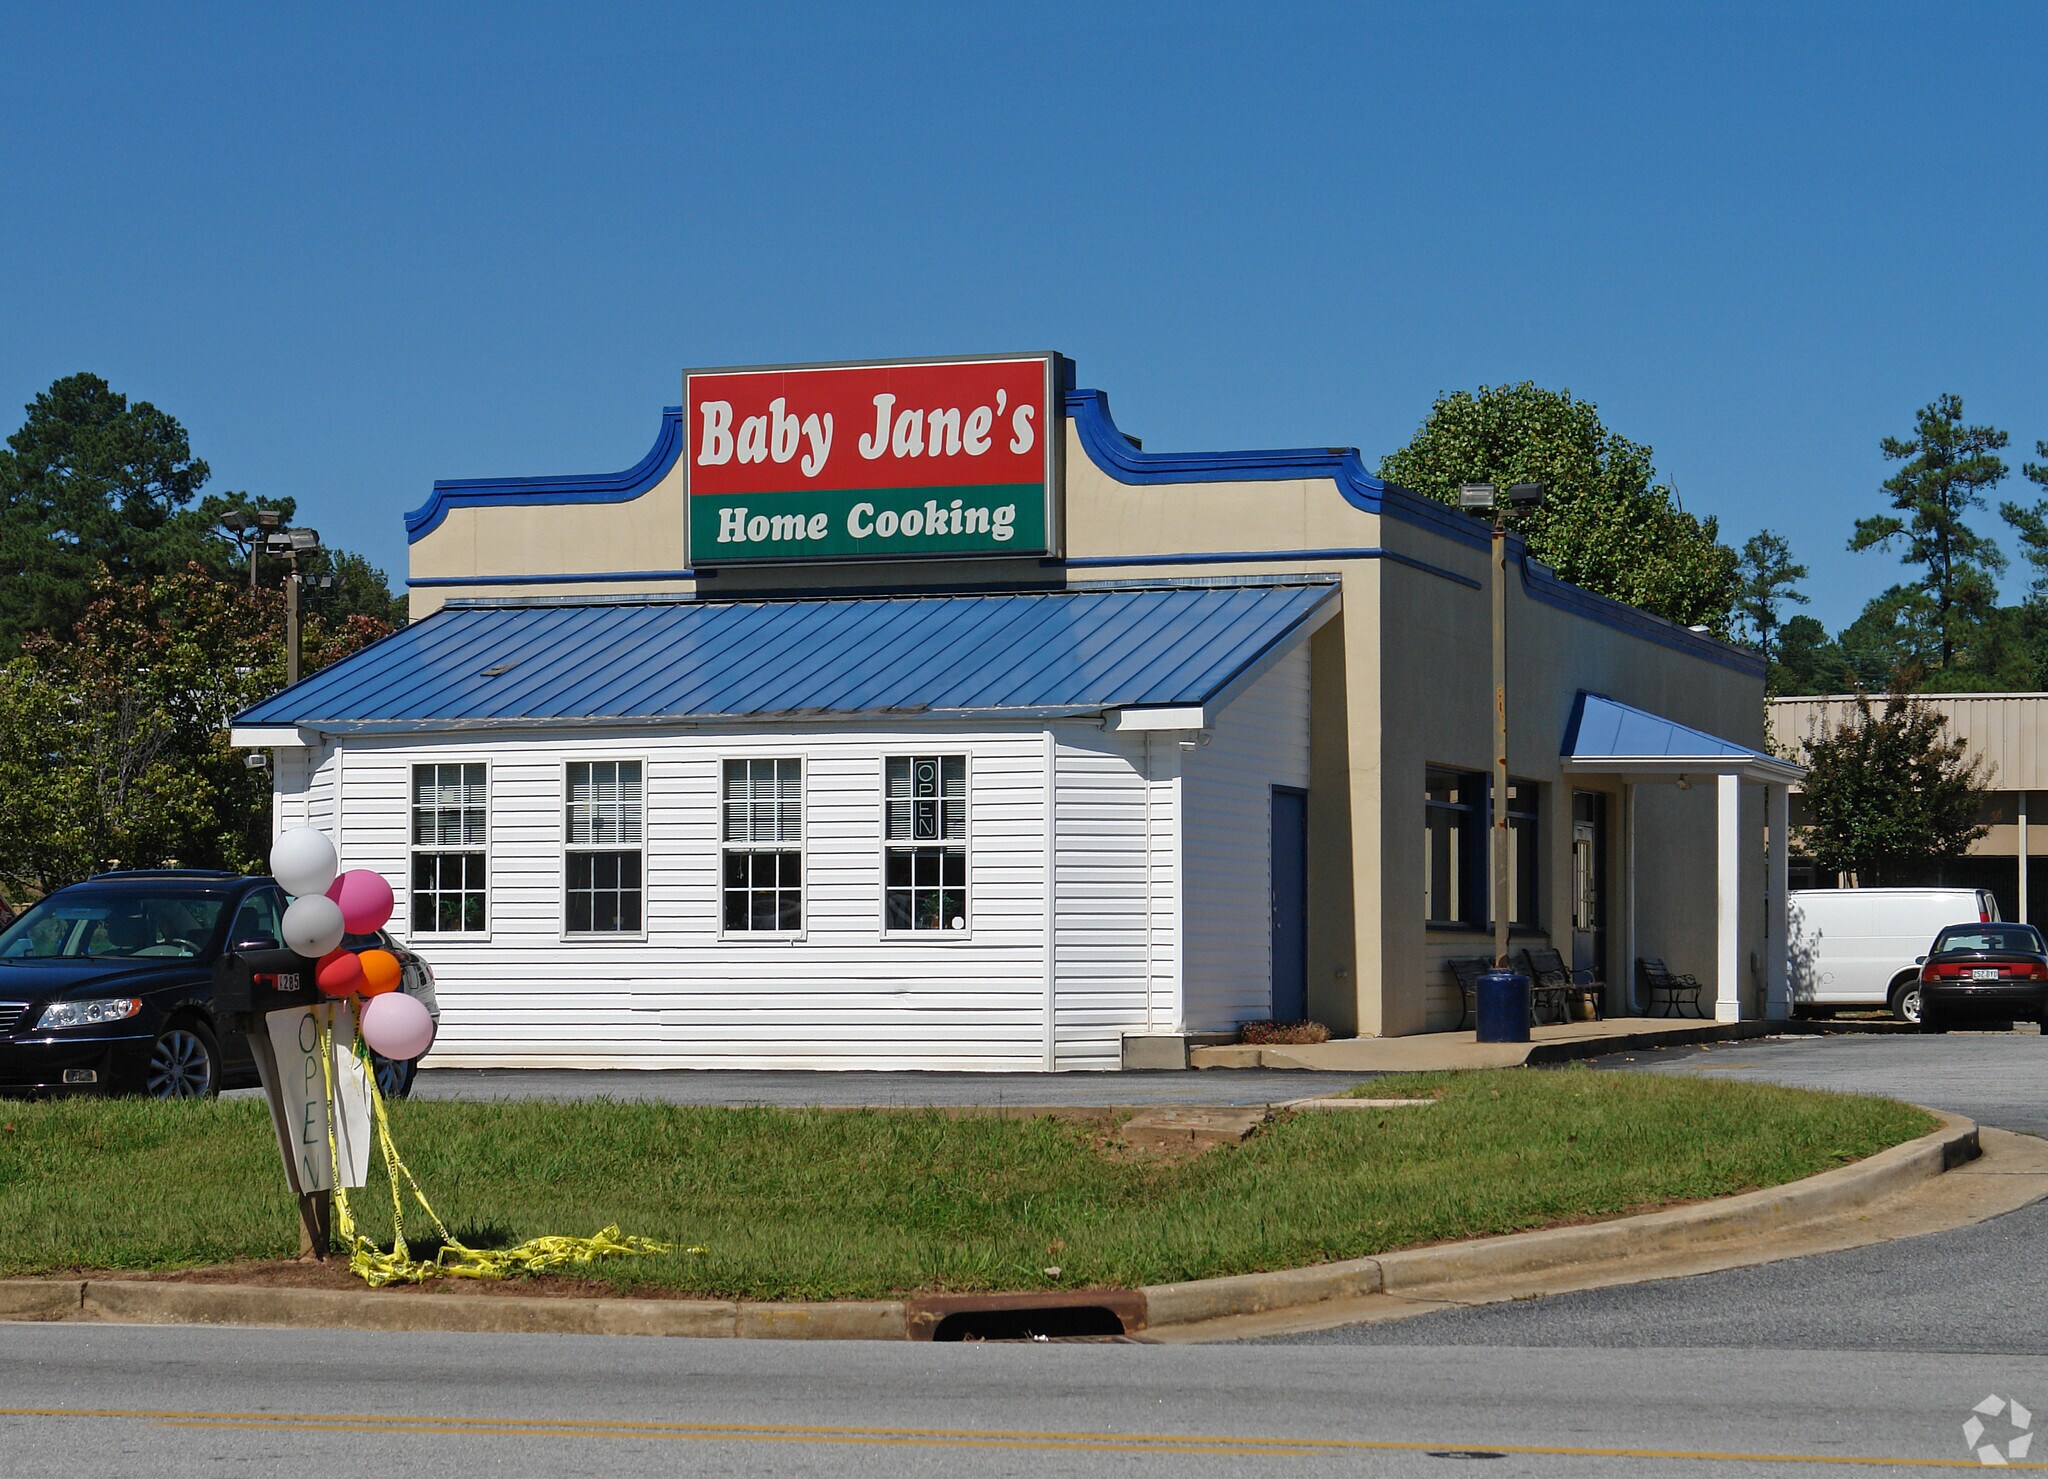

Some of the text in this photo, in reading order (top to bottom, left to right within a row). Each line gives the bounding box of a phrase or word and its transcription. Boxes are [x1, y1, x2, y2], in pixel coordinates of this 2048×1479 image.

[697, 388, 1035, 478] Baby Jane's
[717, 499, 1015, 542] Home Cooking
[917, 764, 935, 836] OPEN
[298, 1012, 321, 1190] OPEN
